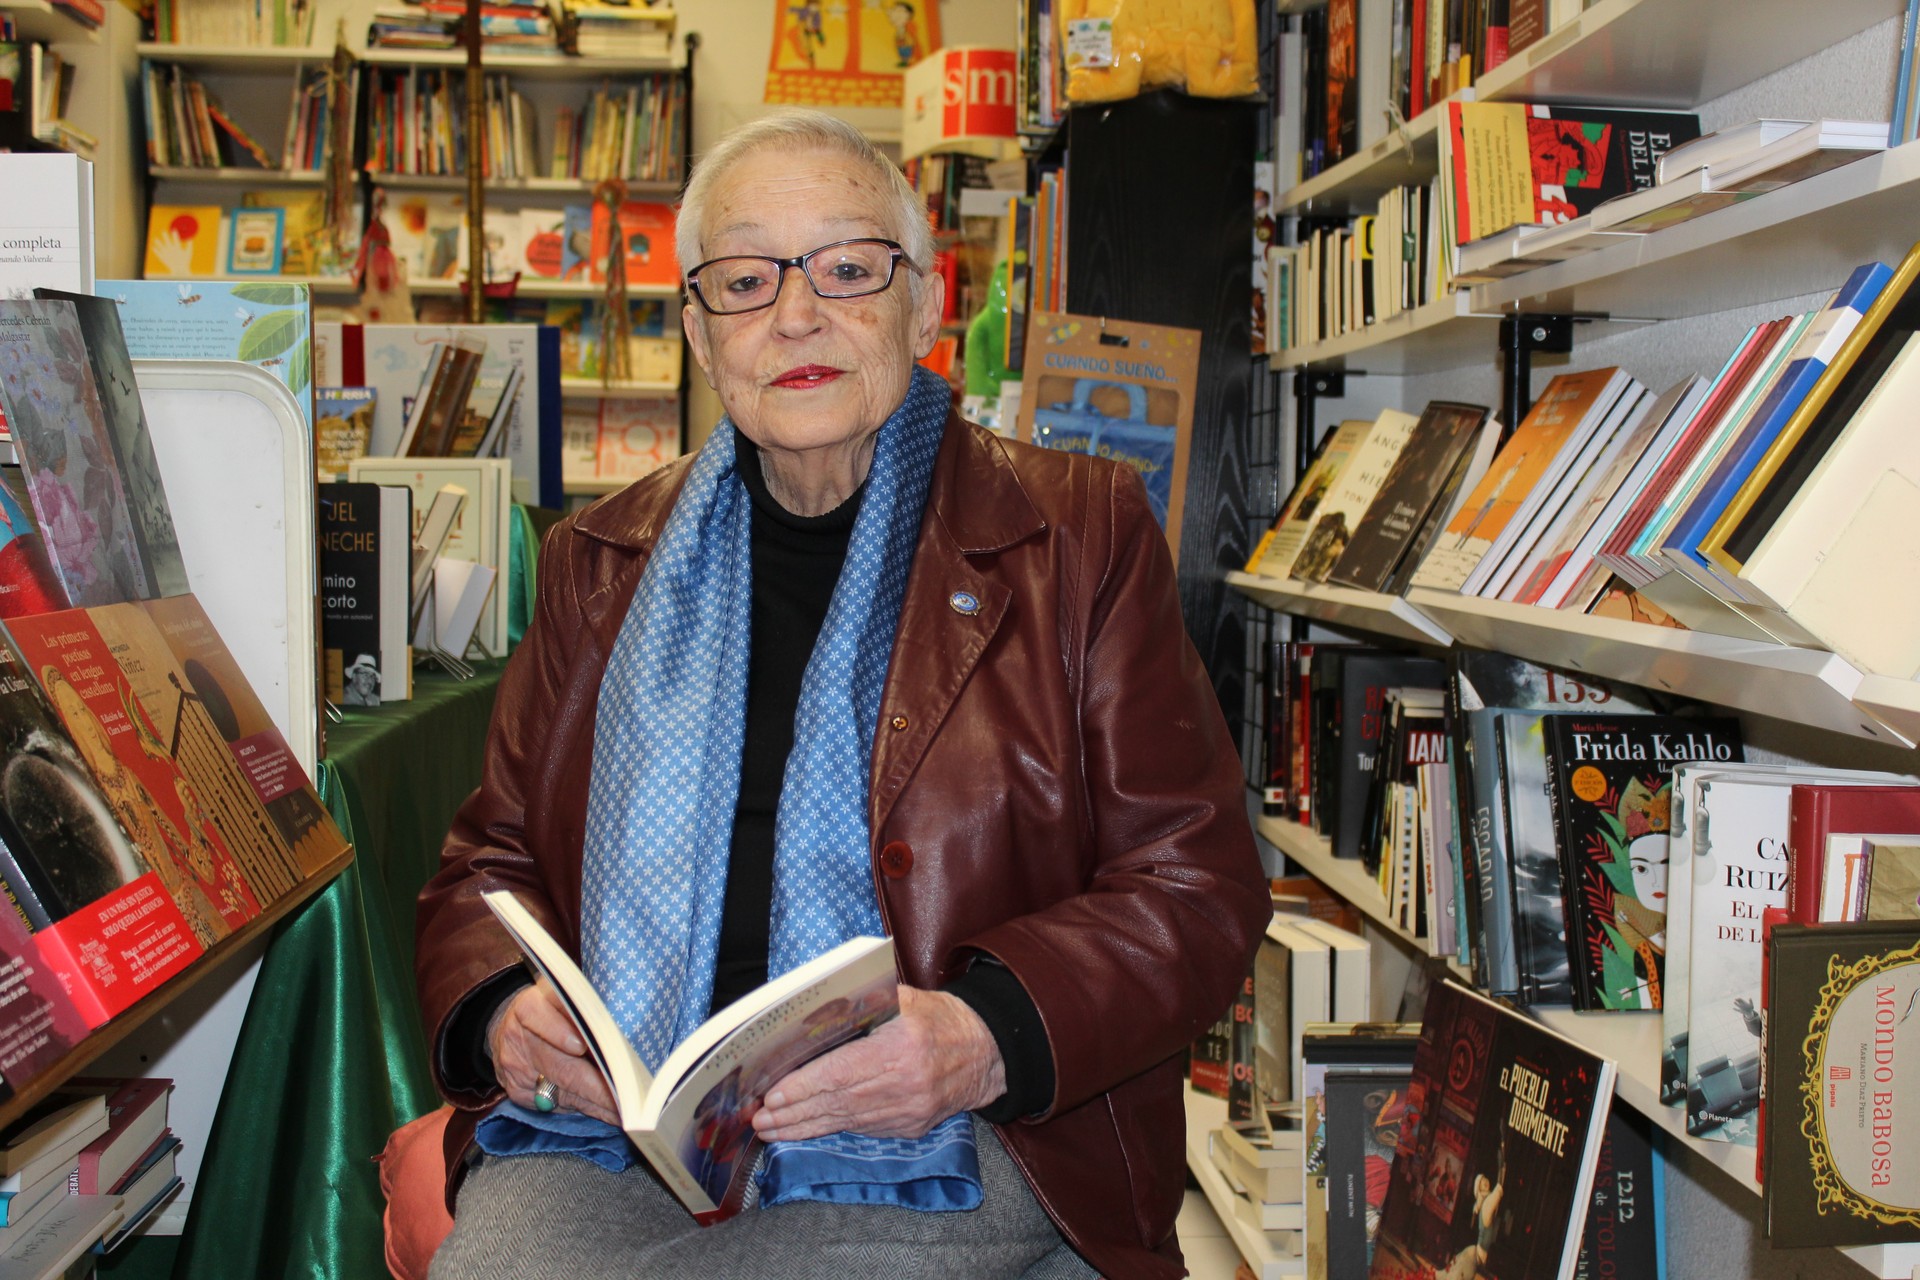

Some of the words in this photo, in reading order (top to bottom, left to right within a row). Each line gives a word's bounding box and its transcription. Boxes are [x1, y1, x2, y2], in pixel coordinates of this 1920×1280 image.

[944, 68, 1015, 107] sm
[1629, 130, 1649, 170] DEL
[3, 236, 62, 253] completa
[23, 254, 54, 264] Valverde
[1044, 352, 1110, 374] CUANDO
[41, 633, 59, 648] Las
[56, 631, 90, 649] primeras
[61, 648, 92, 668] poetisas
[69, 671, 80, 682] en
[77, 665, 105, 680] lengua
[79, 681, 116, 700] castellana
[1572, 722, 1595, 732] María
[1409, 733, 1445, 762] IAN
[1572, 733, 1647, 761] Frida
[1650, 732, 1732, 761] Kahlo
[1724, 864, 1789, 892] RUIZ
[1731, 900, 1759, 920] EL
[1717, 925, 1744, 942] DE
[1859, 1042, 1868, 1081] MARIANO
[1499, 1067, 1510, 1092] EL
[1509, 1063, 1550, 1111] PUEBLO
[1829, 1083, 1837, 1109] pipala
[1708, 1113, 1733, 1123] Planeta
[1858, 1101, 1867, 1129] PRIETO
[1507, 1097, 1569, 1159] DURMIENTE
[1595, 1191, 1608, 1207] de
[1617, 1170, 1634, 1224] 1212
